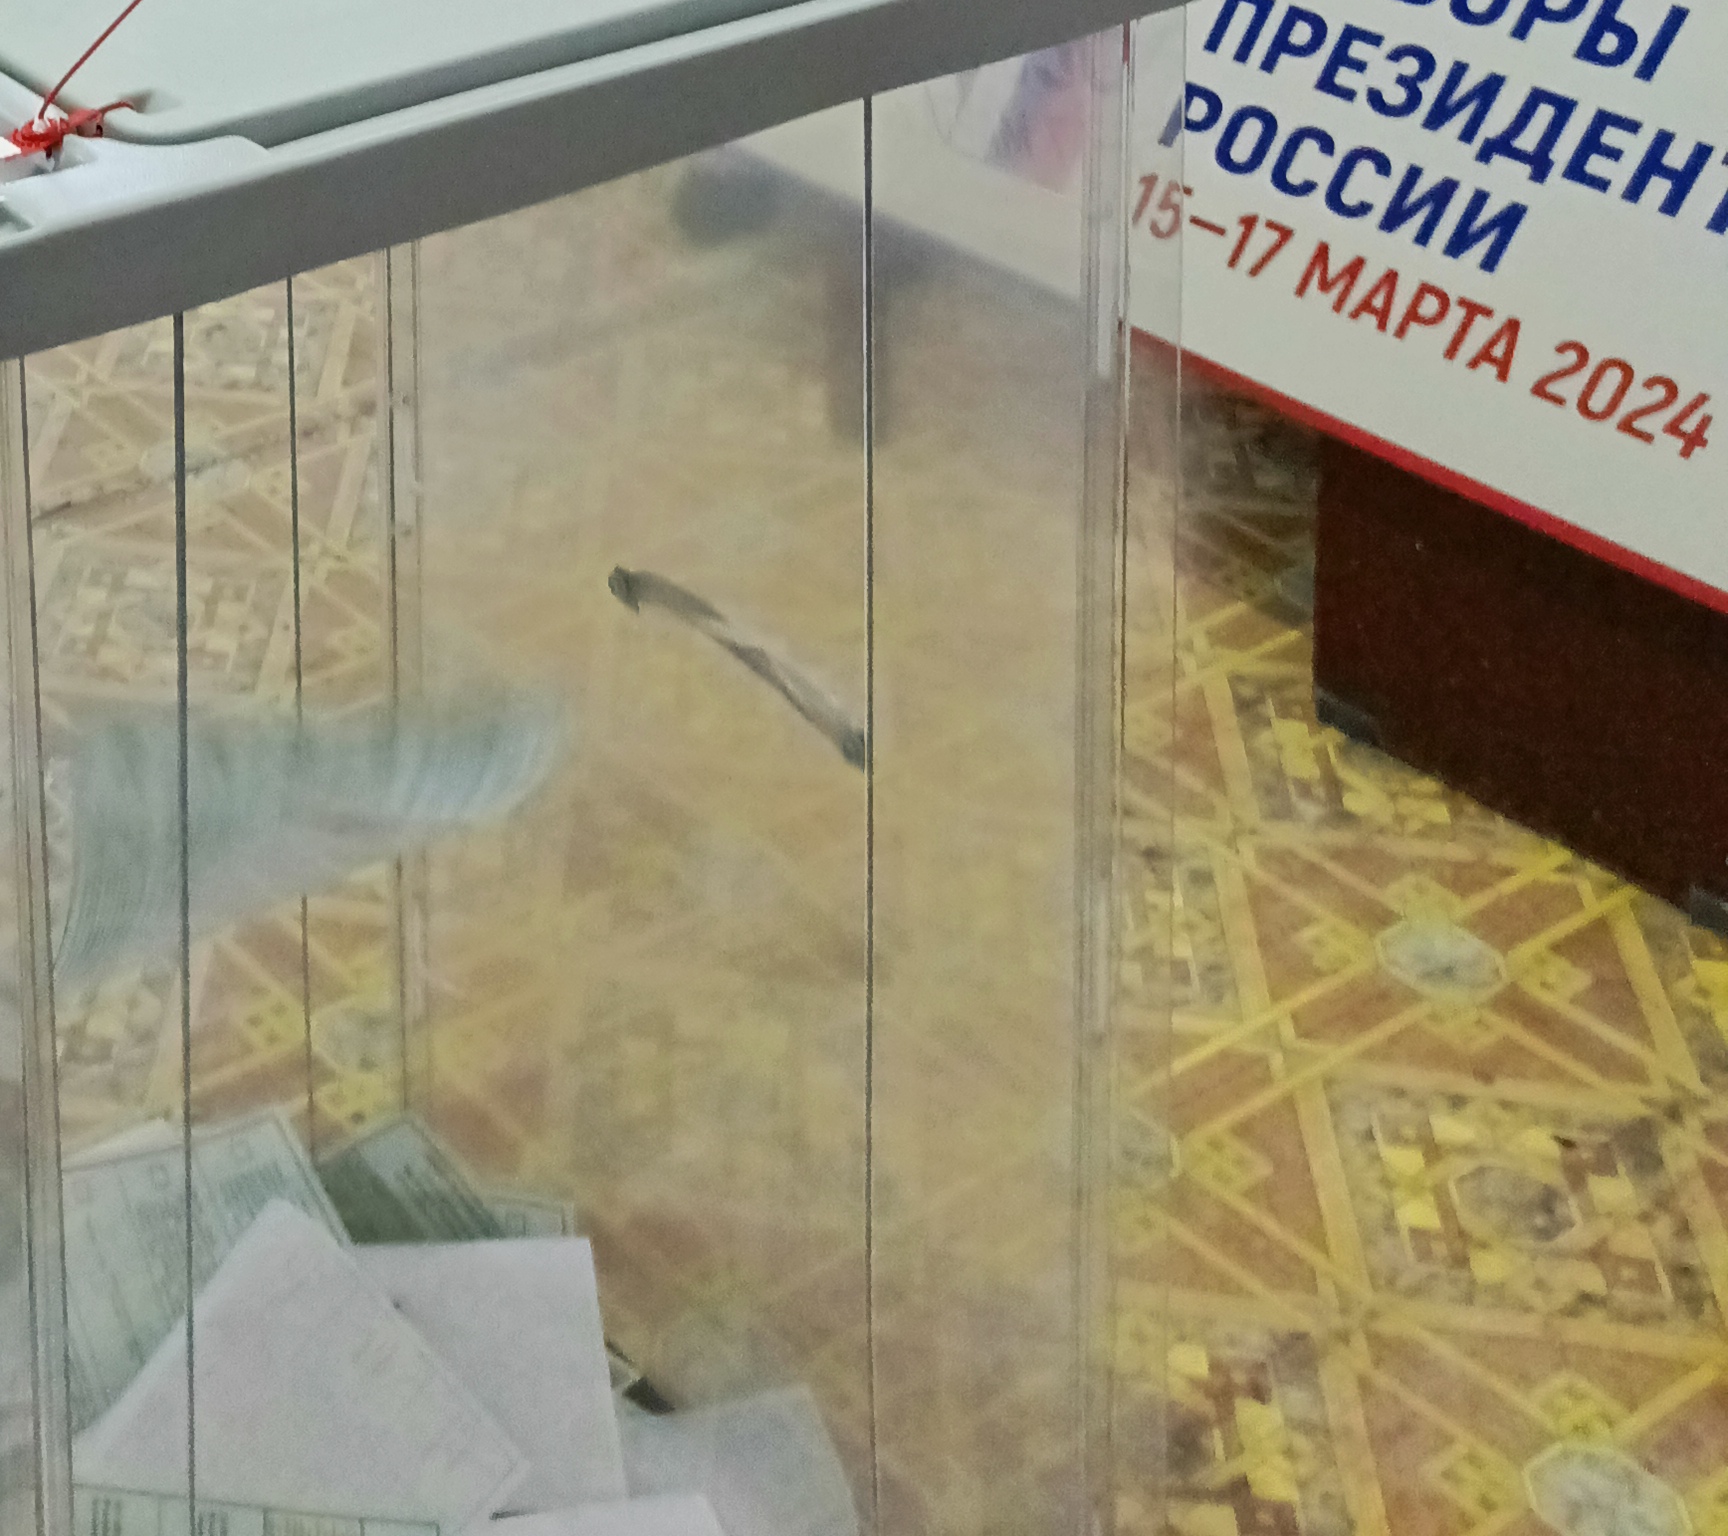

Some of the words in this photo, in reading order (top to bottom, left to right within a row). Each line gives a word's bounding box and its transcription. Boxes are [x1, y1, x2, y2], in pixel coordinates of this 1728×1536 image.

[1158, 81, 1529, 274] РОССИИ
[1294, 239, 1522, 383] МАРТА
[1530, 338, 1714, 461] 2024
